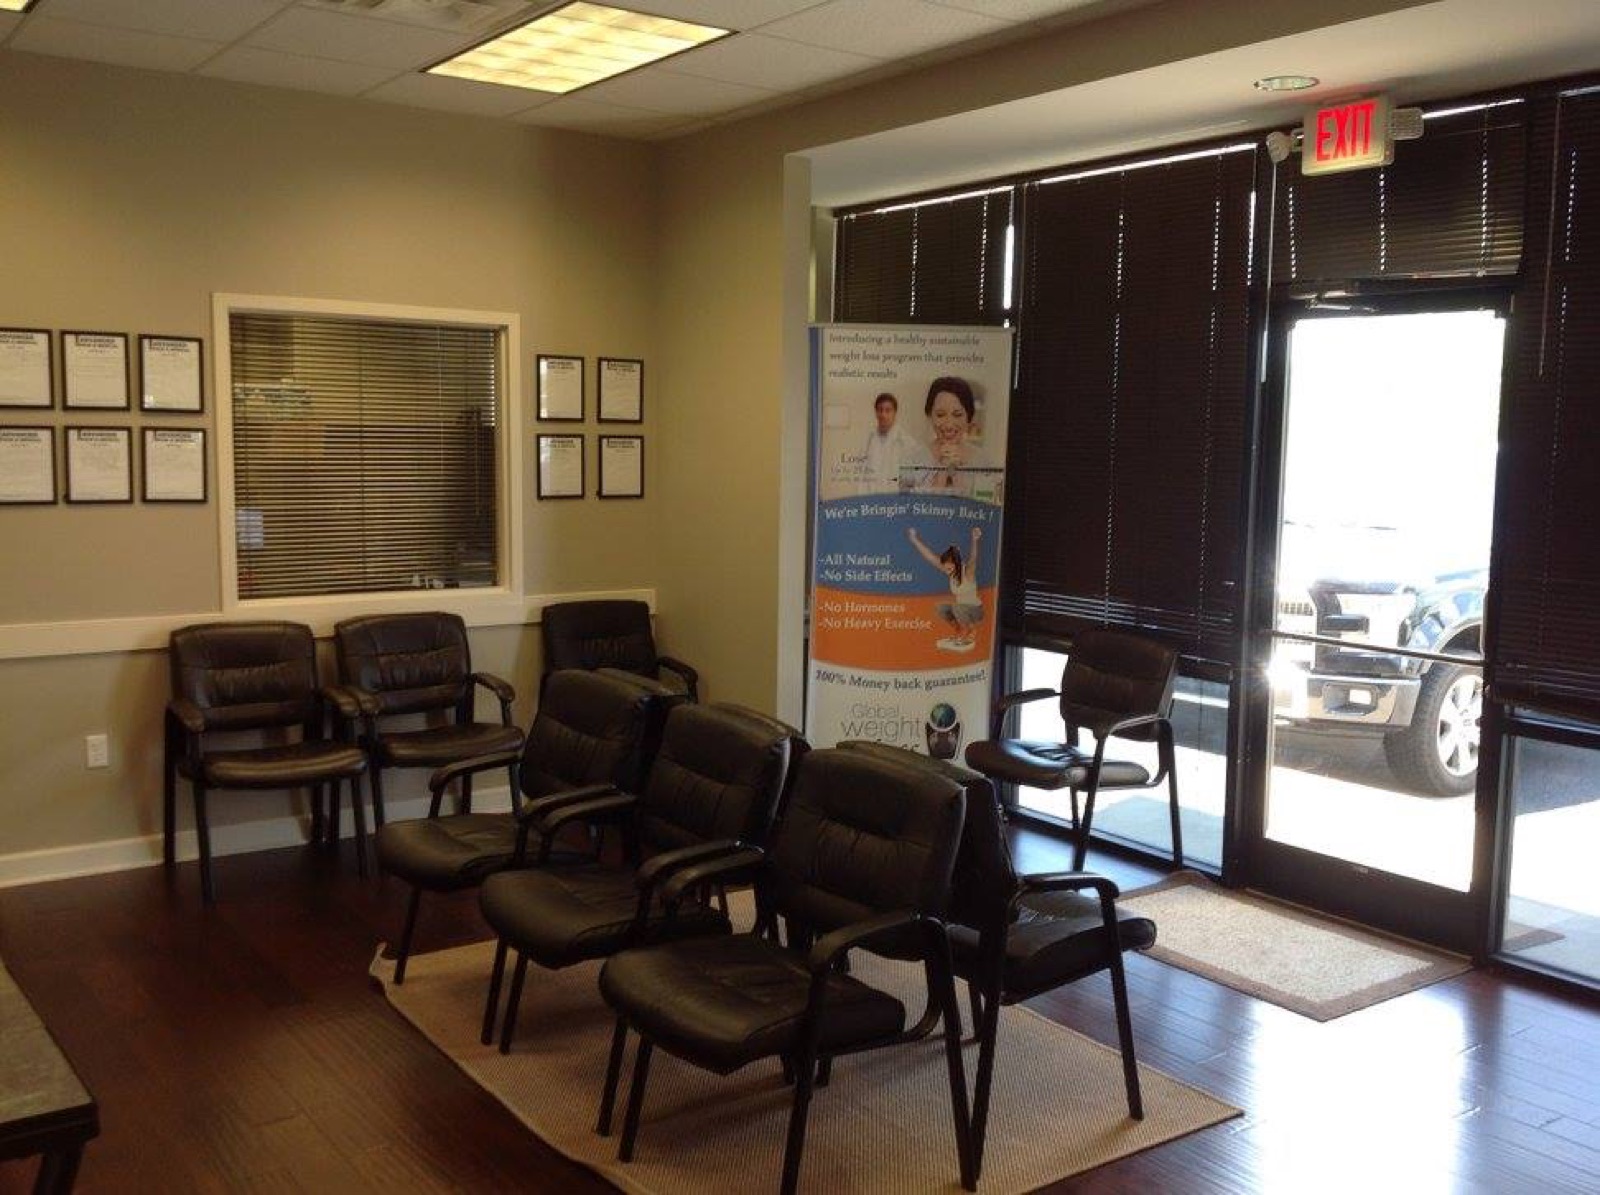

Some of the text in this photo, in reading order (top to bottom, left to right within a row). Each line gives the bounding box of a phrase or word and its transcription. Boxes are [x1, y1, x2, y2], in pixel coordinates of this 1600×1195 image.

[1316, 101, 1376, 162] EXIT
[829, 333, 883, 345] Introducing
[893, 333, 926, 346] healthy
[929, 334, 980, 345] sustainable
[830, 351, 984, 364] weight loss program that provides
[829, 368, 897, 378] realistic results
[825, 507, 858, 520] We're
[860, 503, 910, 517] Bringin'
[913, 503, 955, 519] Skinny
[847, 554, 891, 565] Natural
[845, 569, 872, 581] Side
[874, 570, 913, 582] Effects
[845, 602, 906, 613] Hormones
[844, 618, 881, 630] Heavy
[885, 618, 932, 630] Exercise
[816, 669, 986, 691] 100% Money back guarantee!
[851, 702, 899, 719] Global
[840, 717, 921, 742] weight
